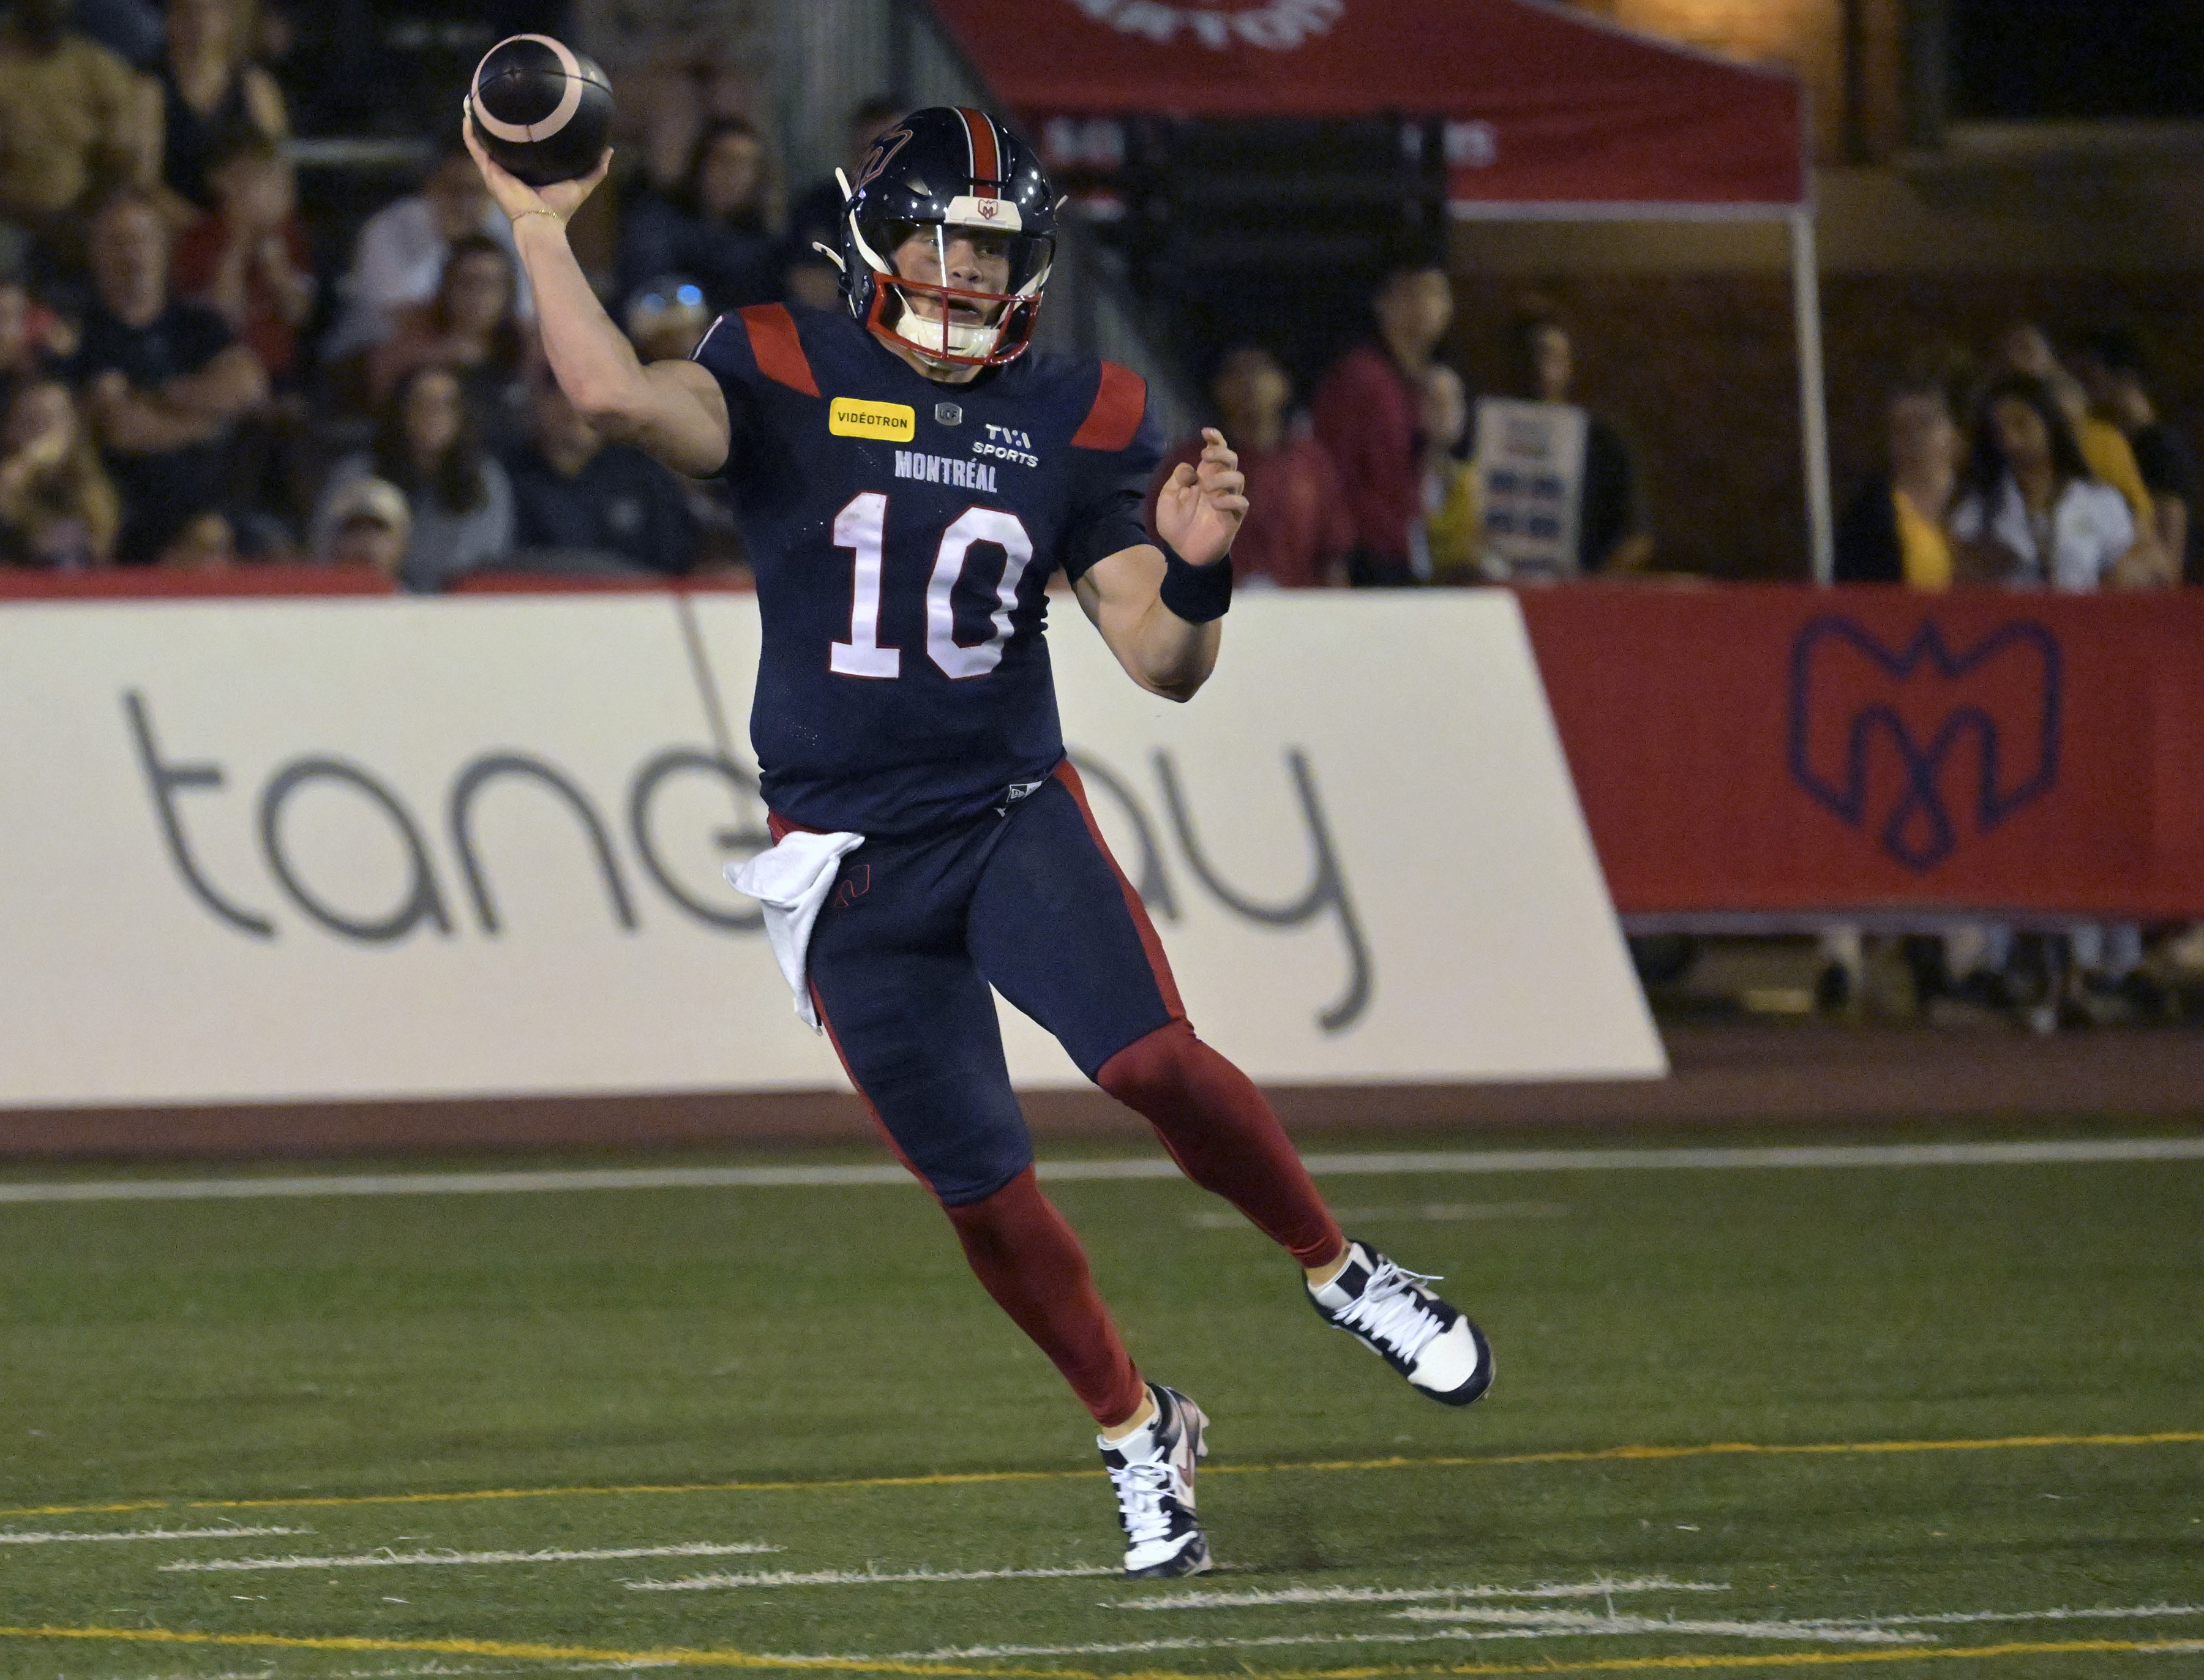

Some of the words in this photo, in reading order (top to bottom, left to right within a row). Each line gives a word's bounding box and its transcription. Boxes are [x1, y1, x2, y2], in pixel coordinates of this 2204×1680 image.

[838, 411, 908, 429] VIDÉOTRON
[894, 450, 997, 493] MONTRÉAL
[972, 441, 1038, 468] SPORTS
[830, 492, 1034, 680] 10
